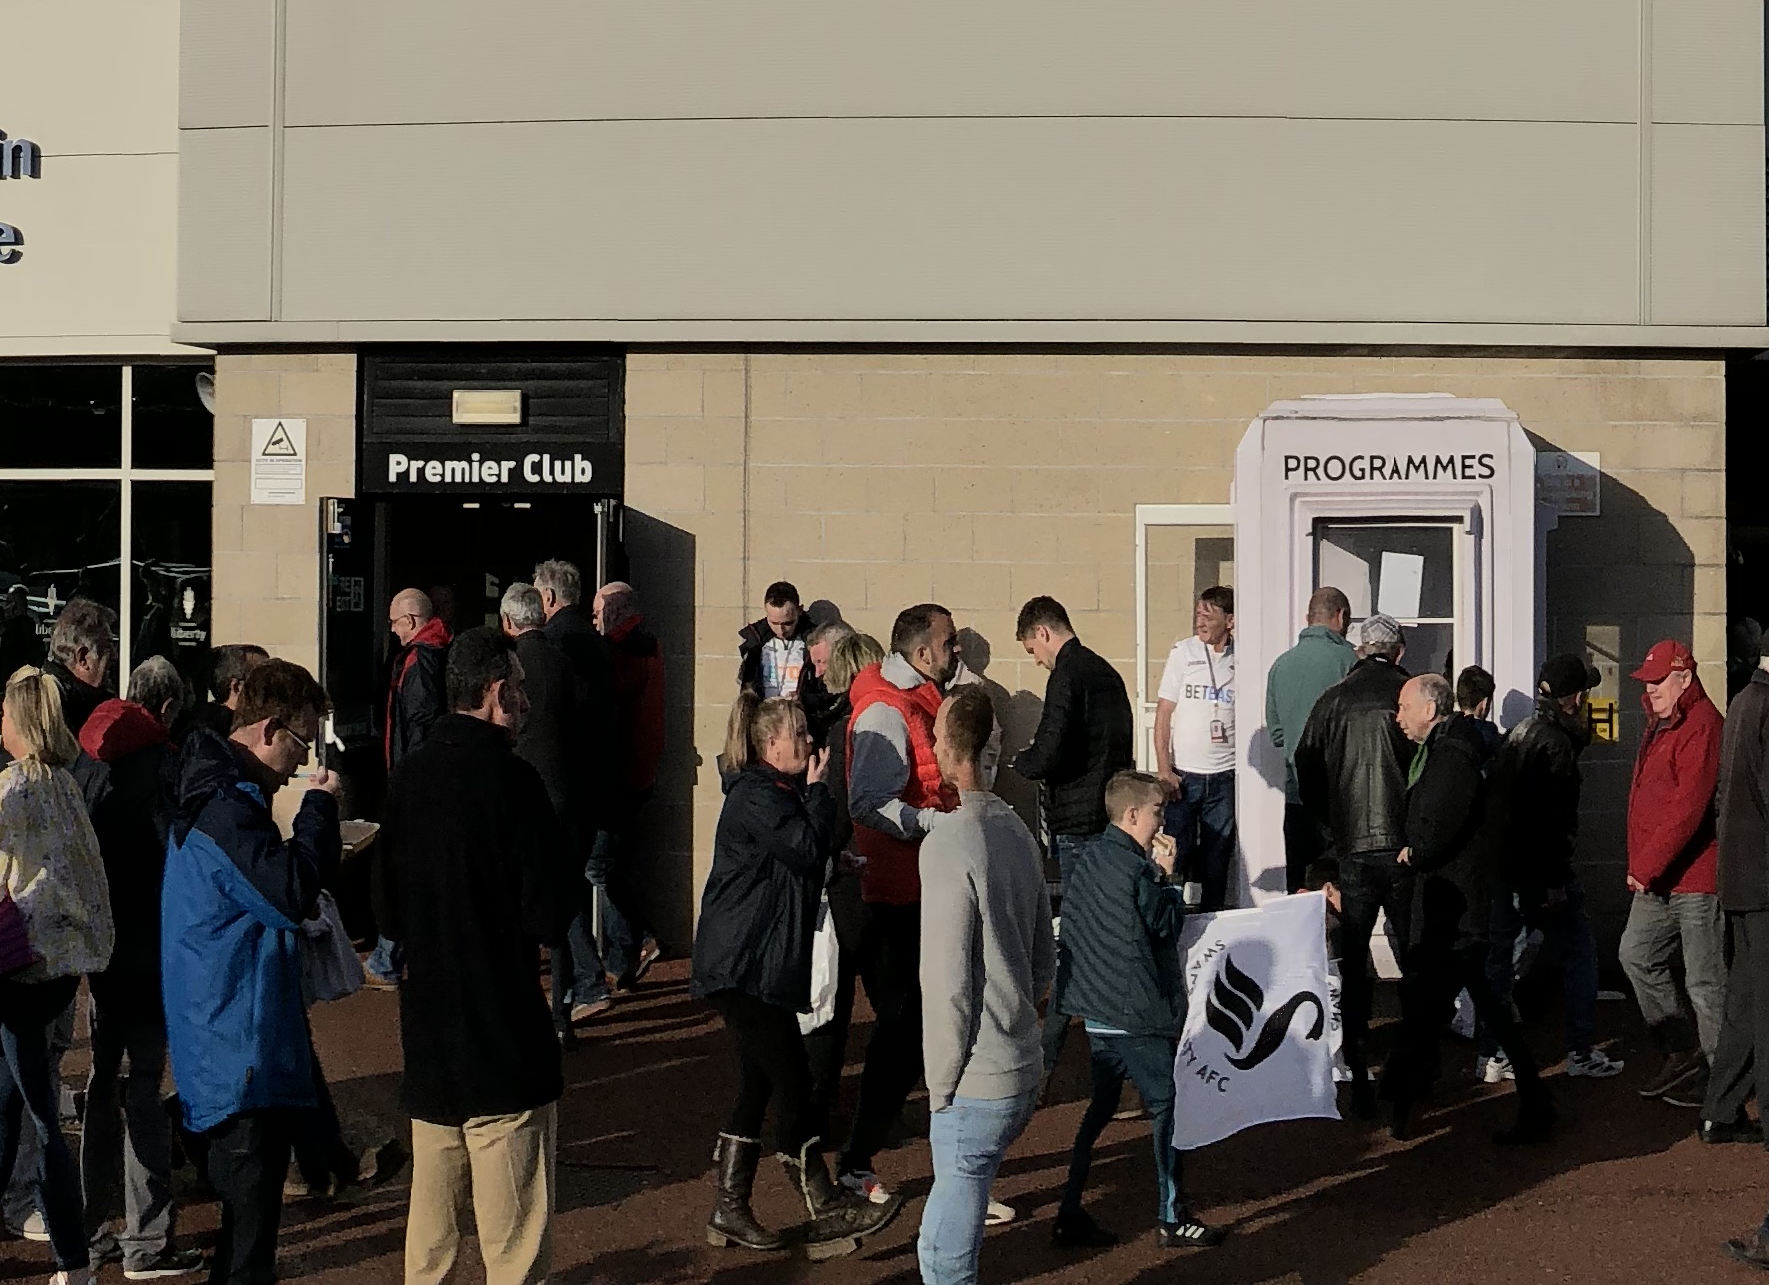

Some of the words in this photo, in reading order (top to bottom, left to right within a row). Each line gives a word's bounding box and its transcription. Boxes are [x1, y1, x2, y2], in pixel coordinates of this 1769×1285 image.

[388, 452, 517, 483] Premier
[523, 453, 593, 483] Club
[1283, 453, 1496, 481] PROGRAMMES
[1195, 1064, 1231, 1093] AFC
